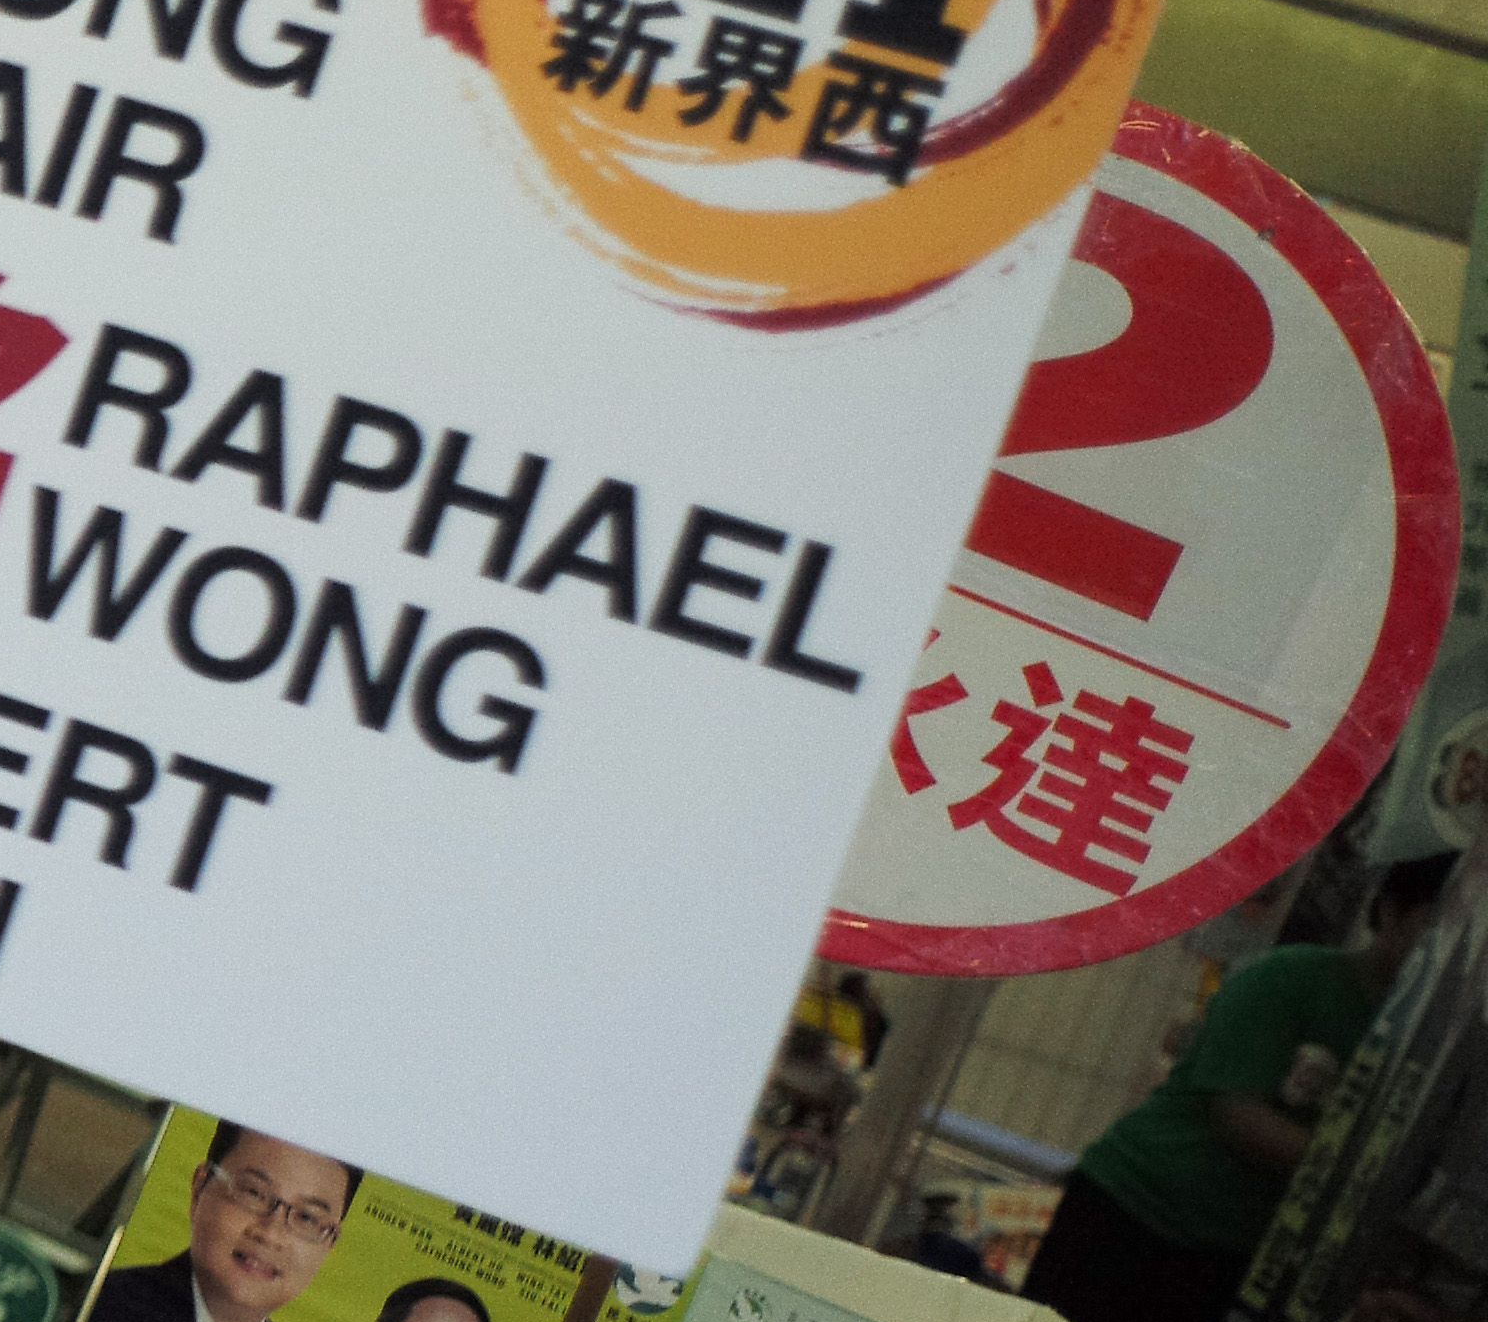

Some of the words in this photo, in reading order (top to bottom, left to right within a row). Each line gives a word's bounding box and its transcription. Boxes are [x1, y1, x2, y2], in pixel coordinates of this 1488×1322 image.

[64, 321, 864, 693] RAPHAEL
[964, 188, 1274, 622] 2
[28, 484, 544, 774] WONG
[532, 1234, 588, 1275] 林紹
